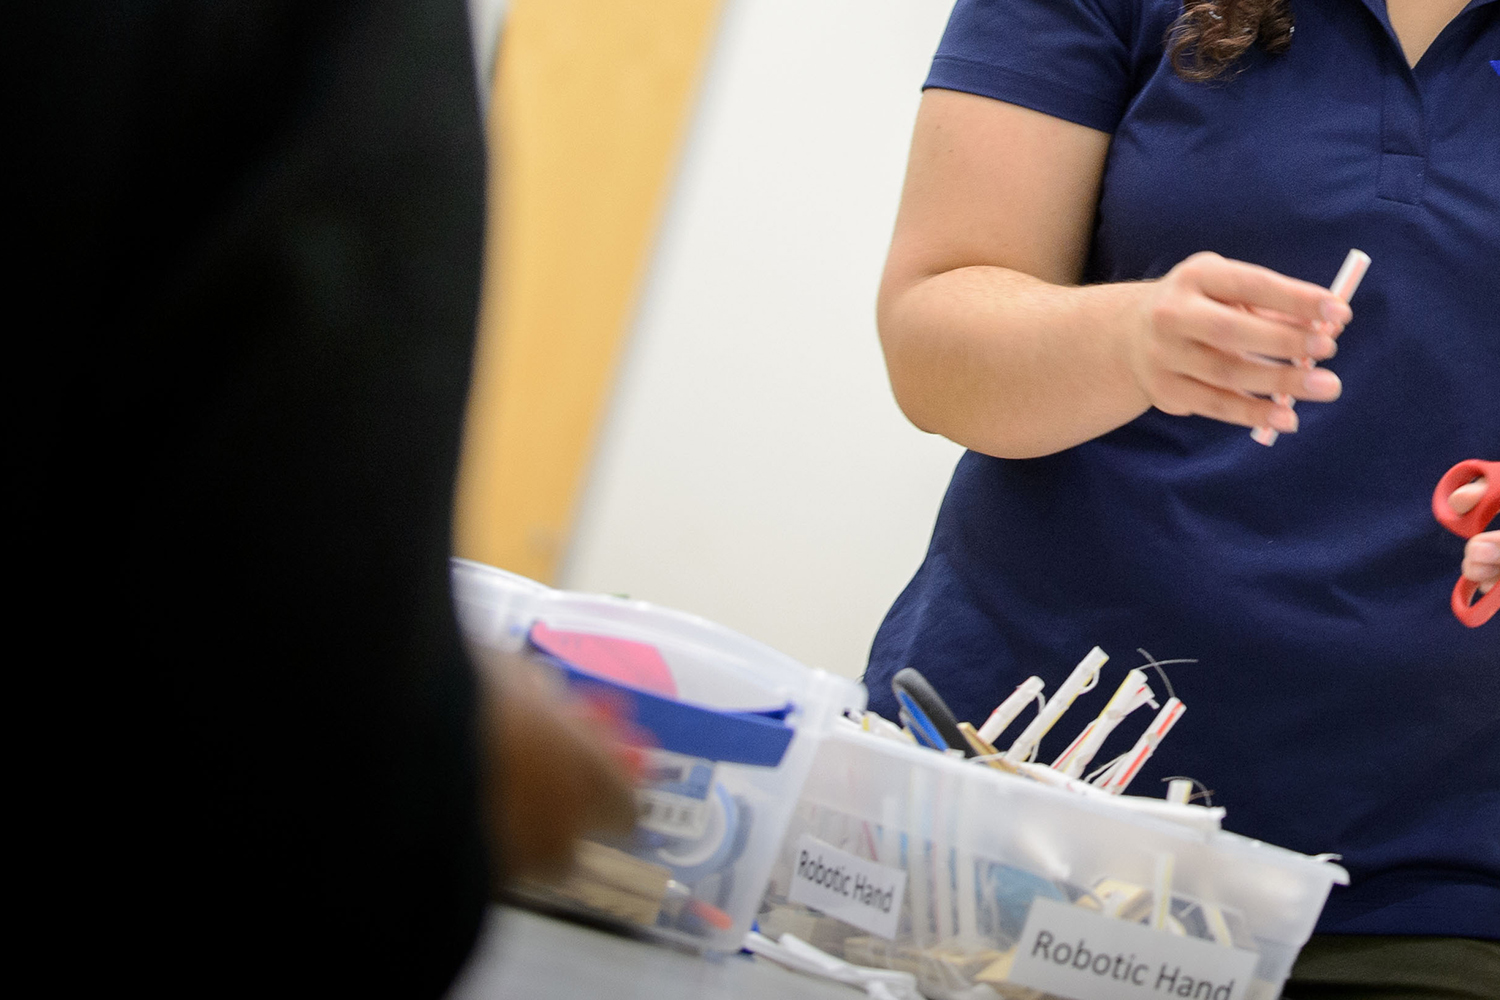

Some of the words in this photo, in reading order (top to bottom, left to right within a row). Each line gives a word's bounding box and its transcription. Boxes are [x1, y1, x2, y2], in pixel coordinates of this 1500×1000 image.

[798, 850, 850, 896] Robotic
[853, 874, 895, 914] Hand
[1031, 929, 1149, 986] Robotic
[1155, 963, 1236, 1000] Hand
